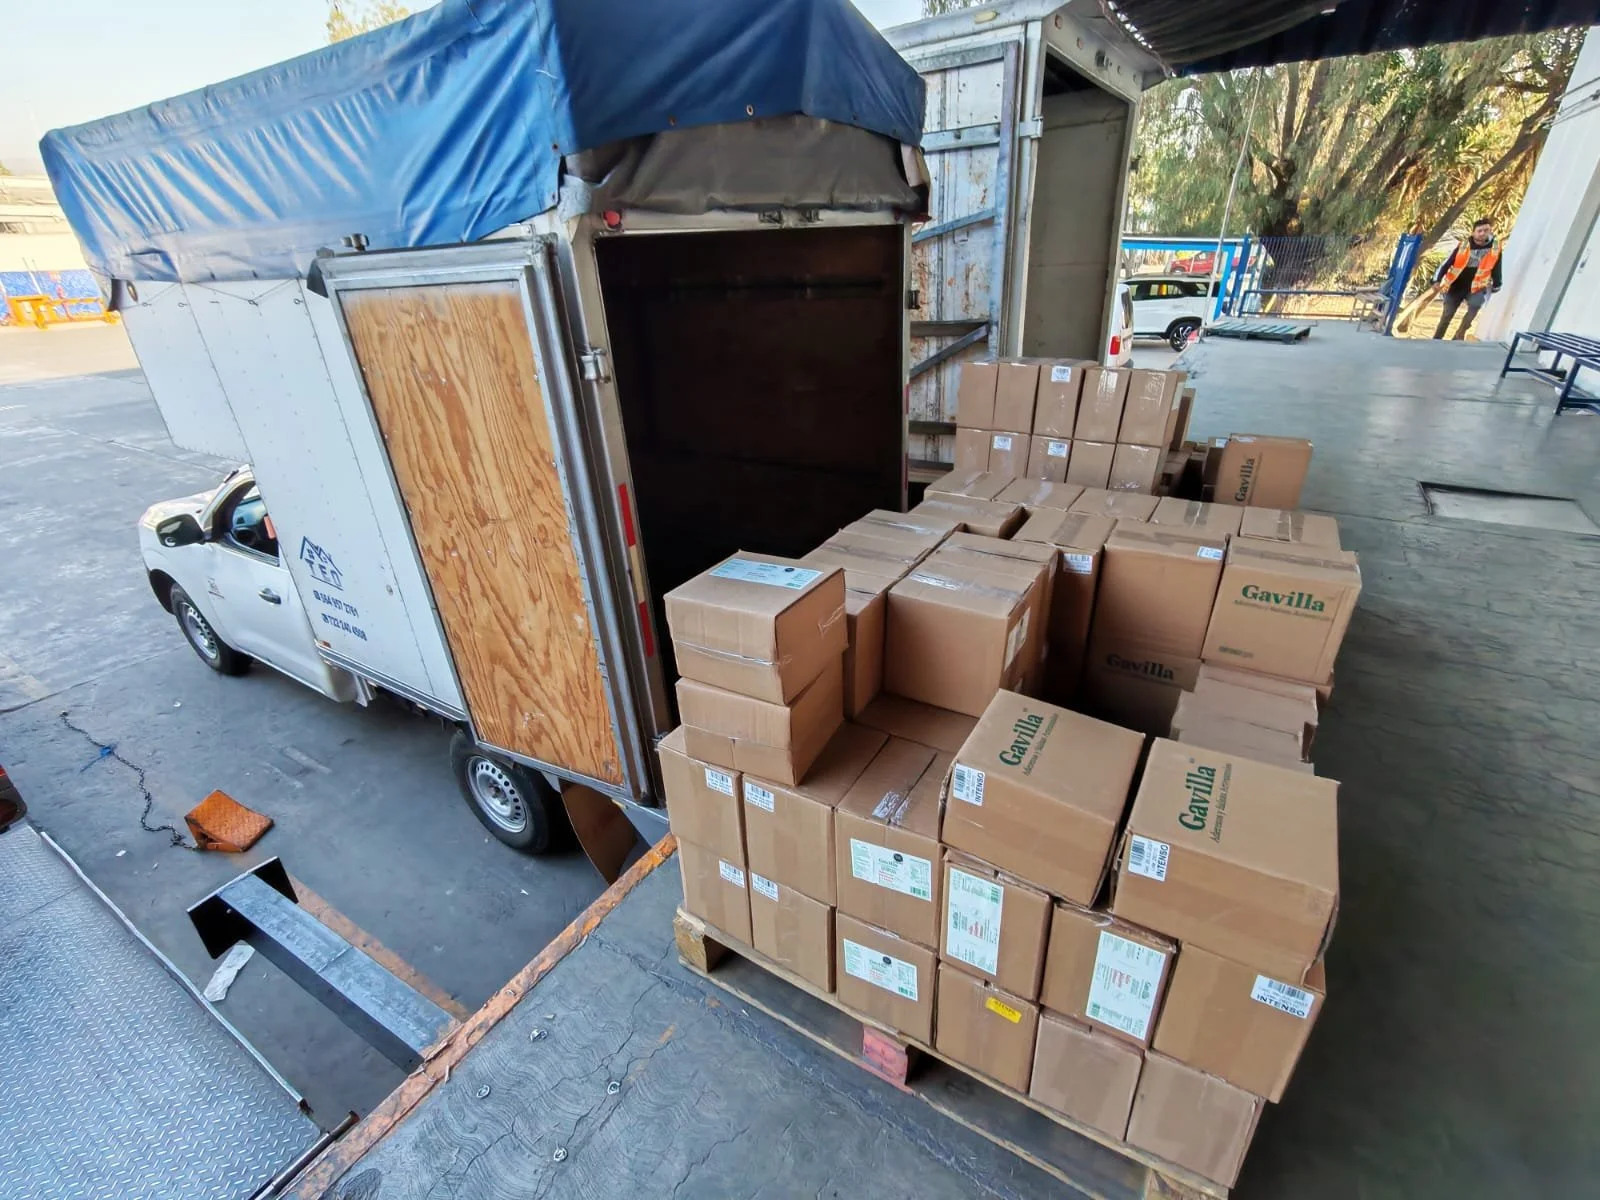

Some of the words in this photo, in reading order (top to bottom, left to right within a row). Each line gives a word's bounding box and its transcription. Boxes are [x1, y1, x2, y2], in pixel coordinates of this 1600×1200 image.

[1234, 458, 1255, 502] Gavilla
[1241, 584, 1326, 612] Gavilla
[1106, 653, 1174, 681] Gavilla
[999, 714, 1044, 766] Gavilla
[975, 773, 984, 802] INTENSO
[1178, 766, 1216, 830] Gavilla
[1156, 844, 1169, 878] INTENSO
[1256, 994, 1305, 1016] INTENSO
